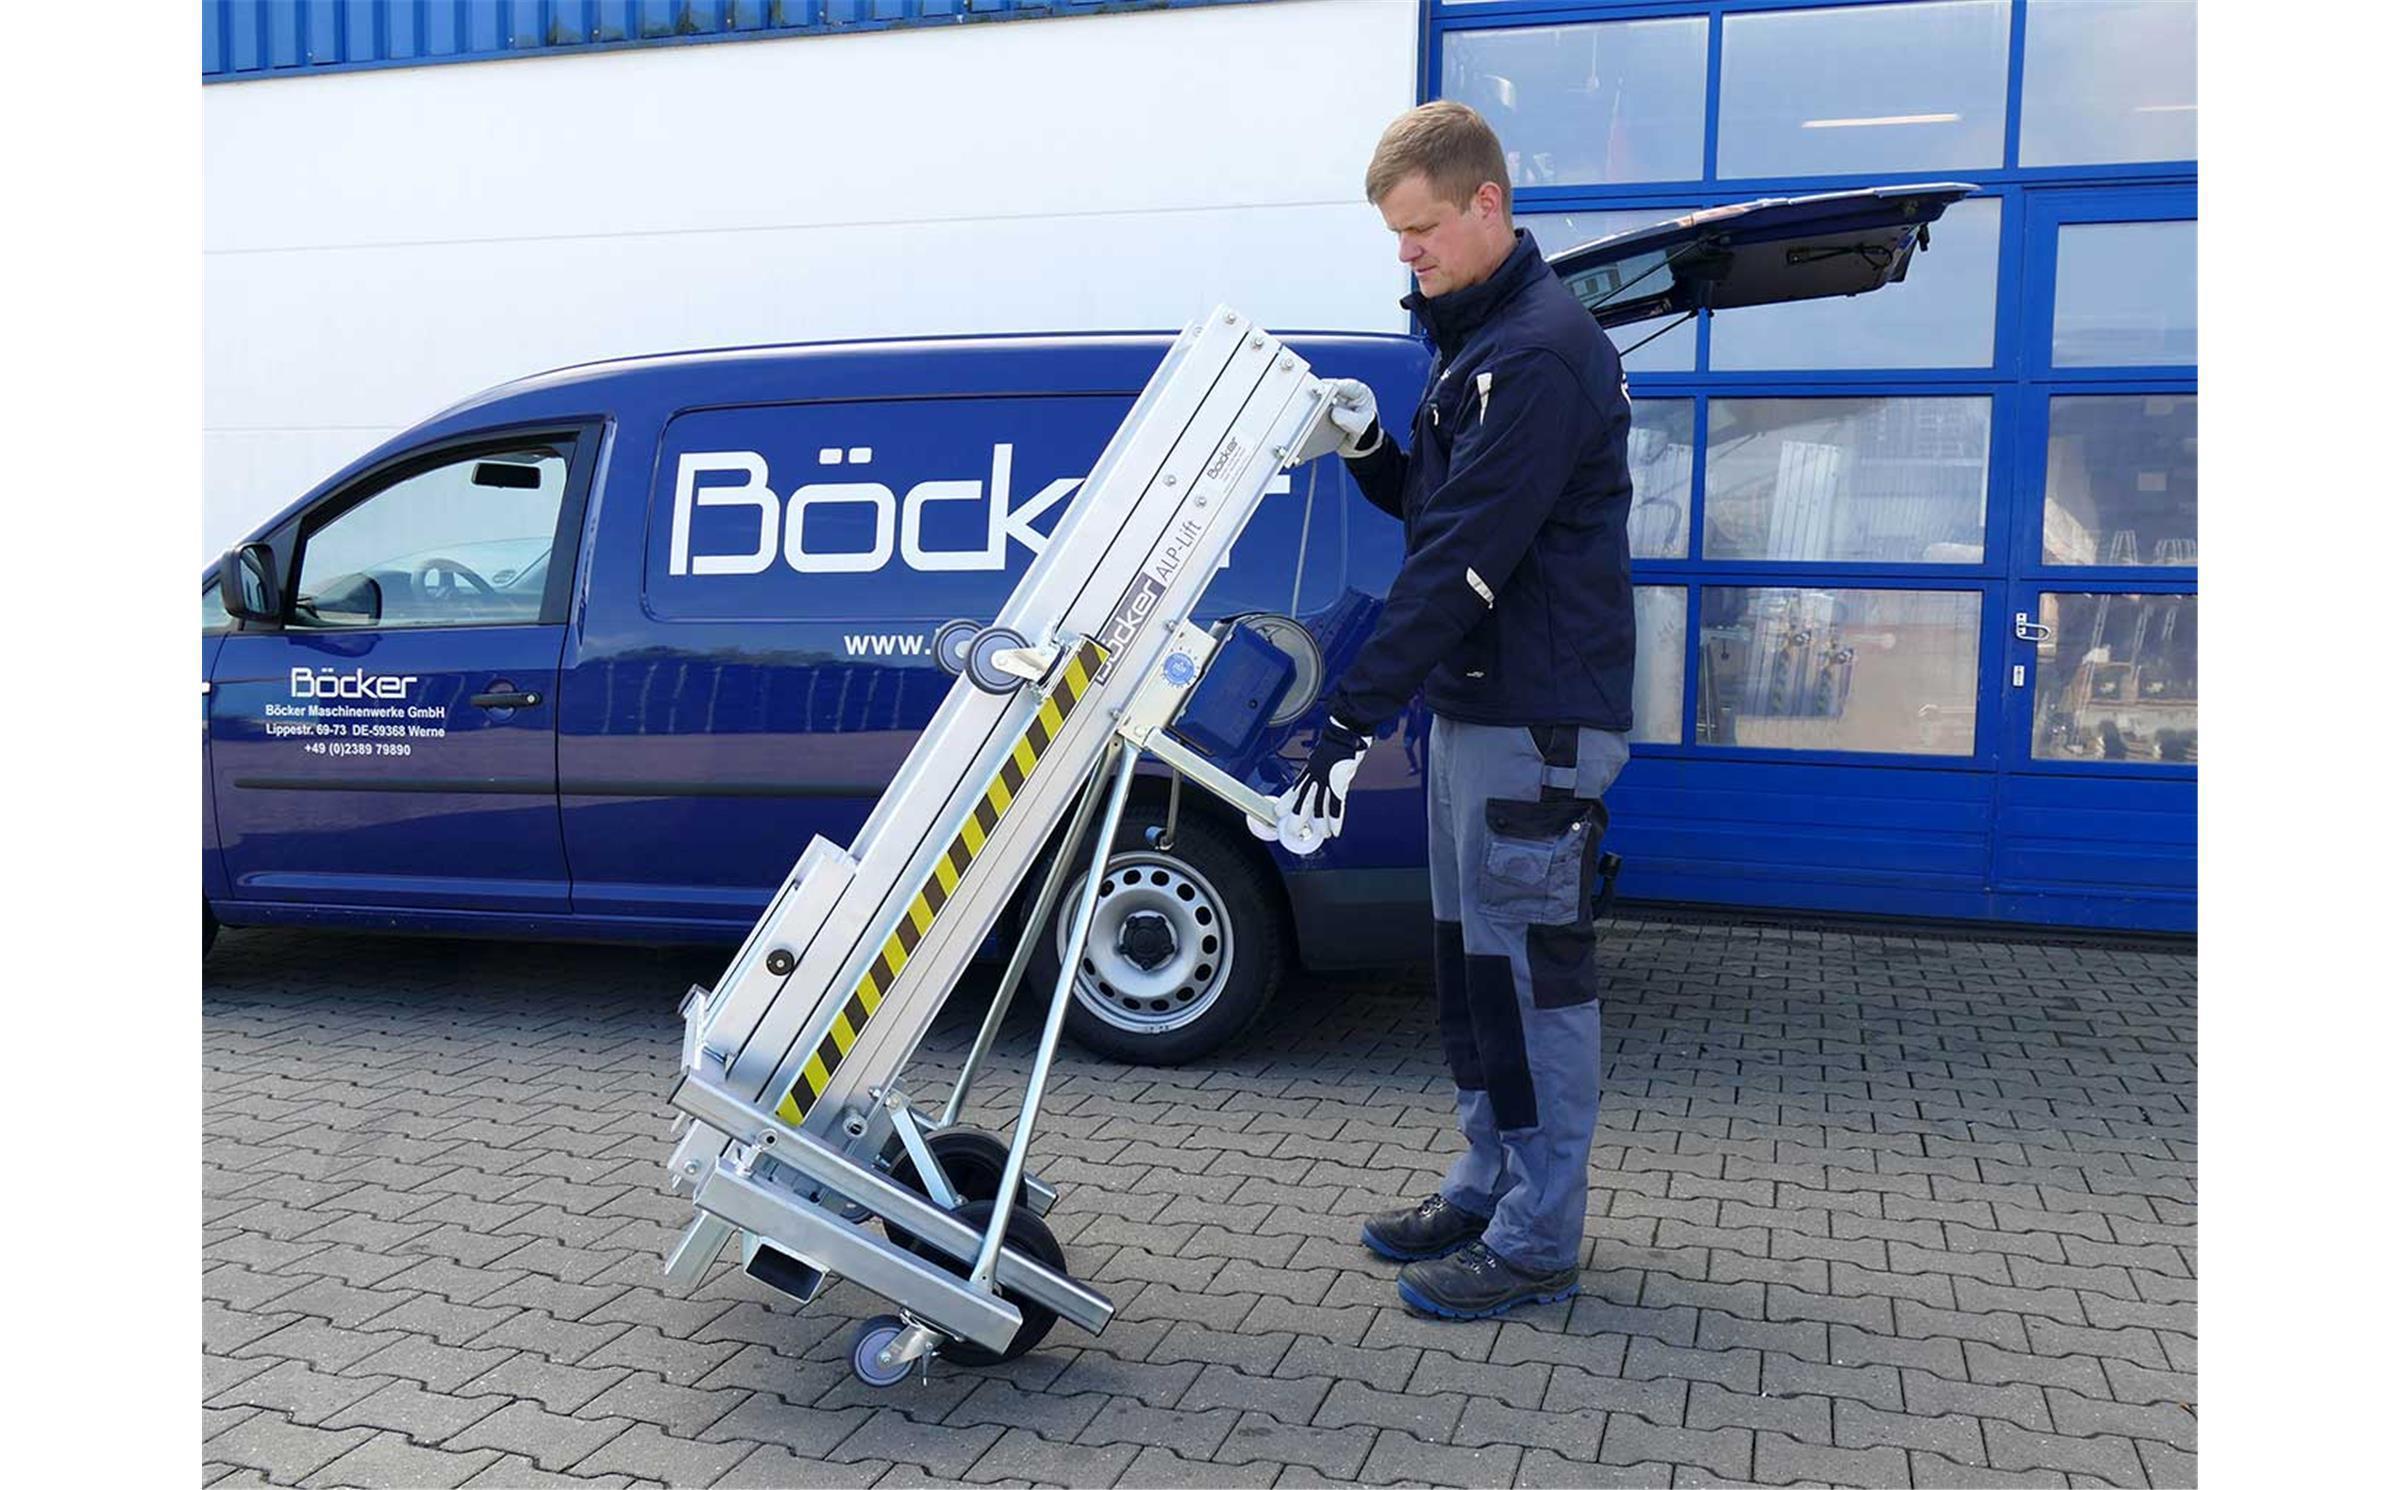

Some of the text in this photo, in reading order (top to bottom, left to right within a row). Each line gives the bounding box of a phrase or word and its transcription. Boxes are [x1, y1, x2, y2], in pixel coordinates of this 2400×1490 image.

[669, 443, 1291, 576] Böck
[1156, 520, 1202, 582] ALP-Lift
[844, 628, 940, 656] www.
[291, 667, 418, 699] Böcker
[265, 703, 445, 719] Böcker Maschinenwerke GmbH
[265, 722, 446, 738] Lippestr. 69-73 DE-59368 Werne
[304, 742, 411, 757] +49 (0)2389 79890
